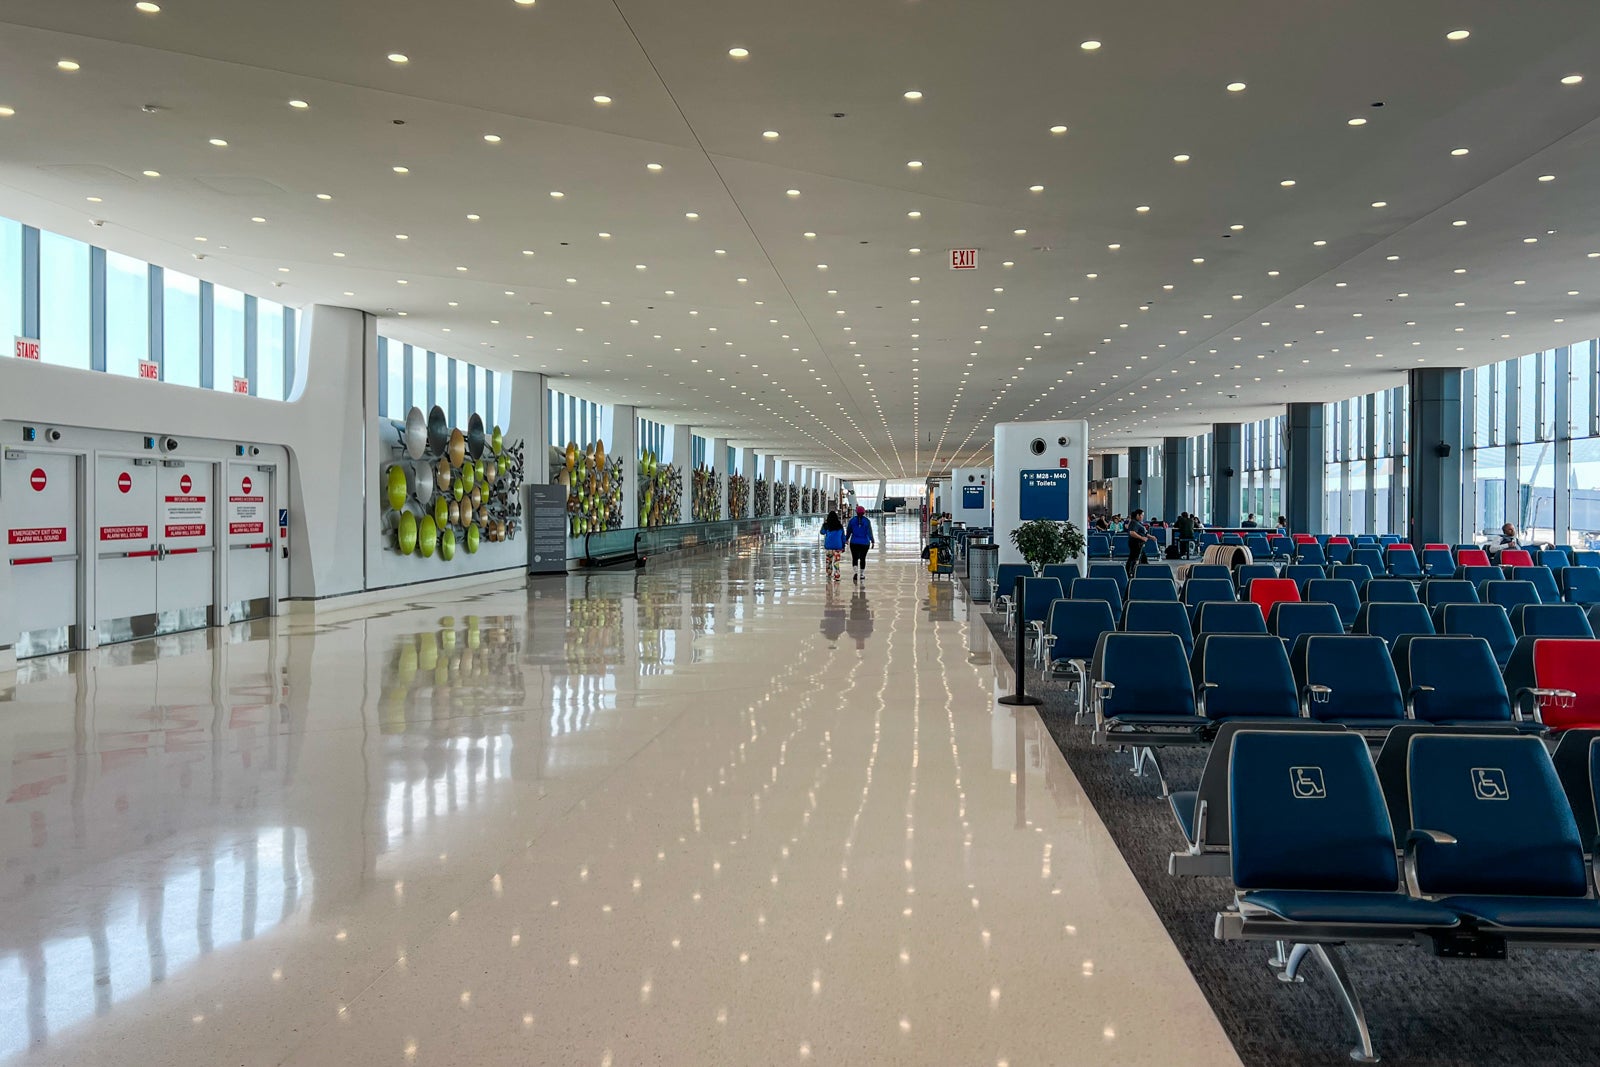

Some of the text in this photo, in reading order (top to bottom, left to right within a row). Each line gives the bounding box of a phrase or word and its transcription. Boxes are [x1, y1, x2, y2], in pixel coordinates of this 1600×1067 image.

[953, 251, 975, 265] EXIT
[16, 341, 39, 360] STAIRS
[140, 363, 157, 379] STAIRS
